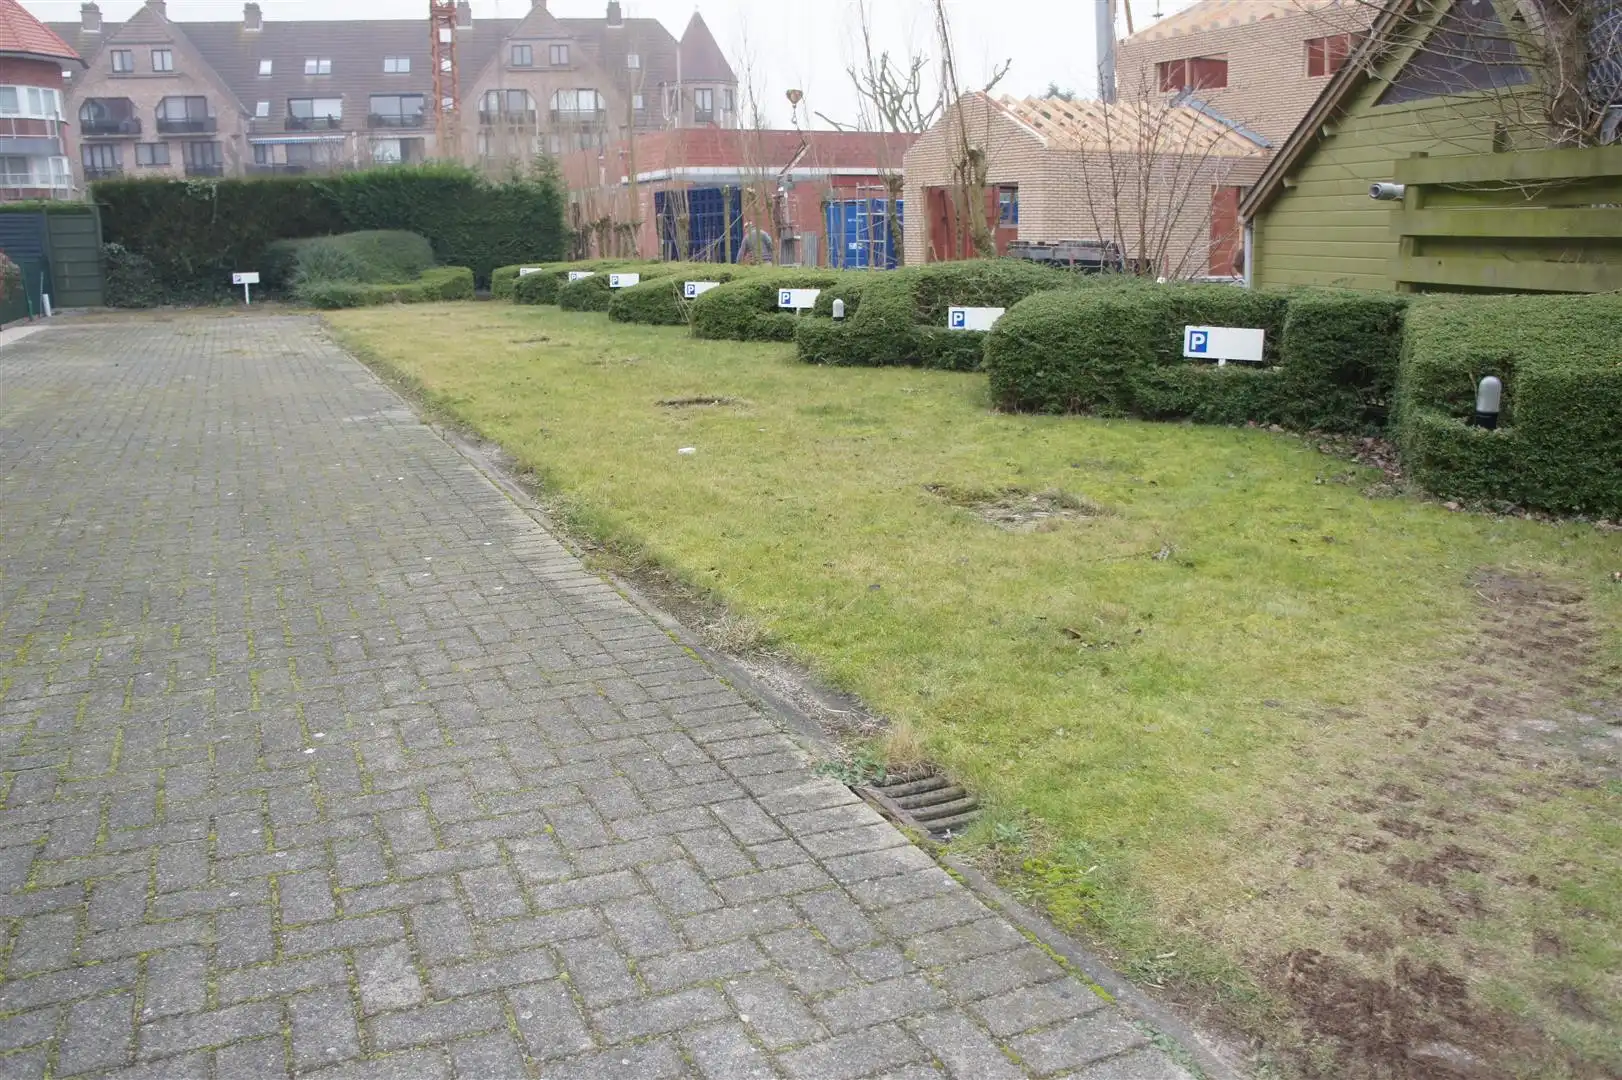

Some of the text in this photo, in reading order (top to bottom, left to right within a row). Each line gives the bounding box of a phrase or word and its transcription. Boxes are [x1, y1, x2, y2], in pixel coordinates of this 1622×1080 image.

[688, 285, 695, 295] P
[782, 292, 790, 304] P
[953, 312, 964, 326] P
[1190, 332, 1206, 351] P
